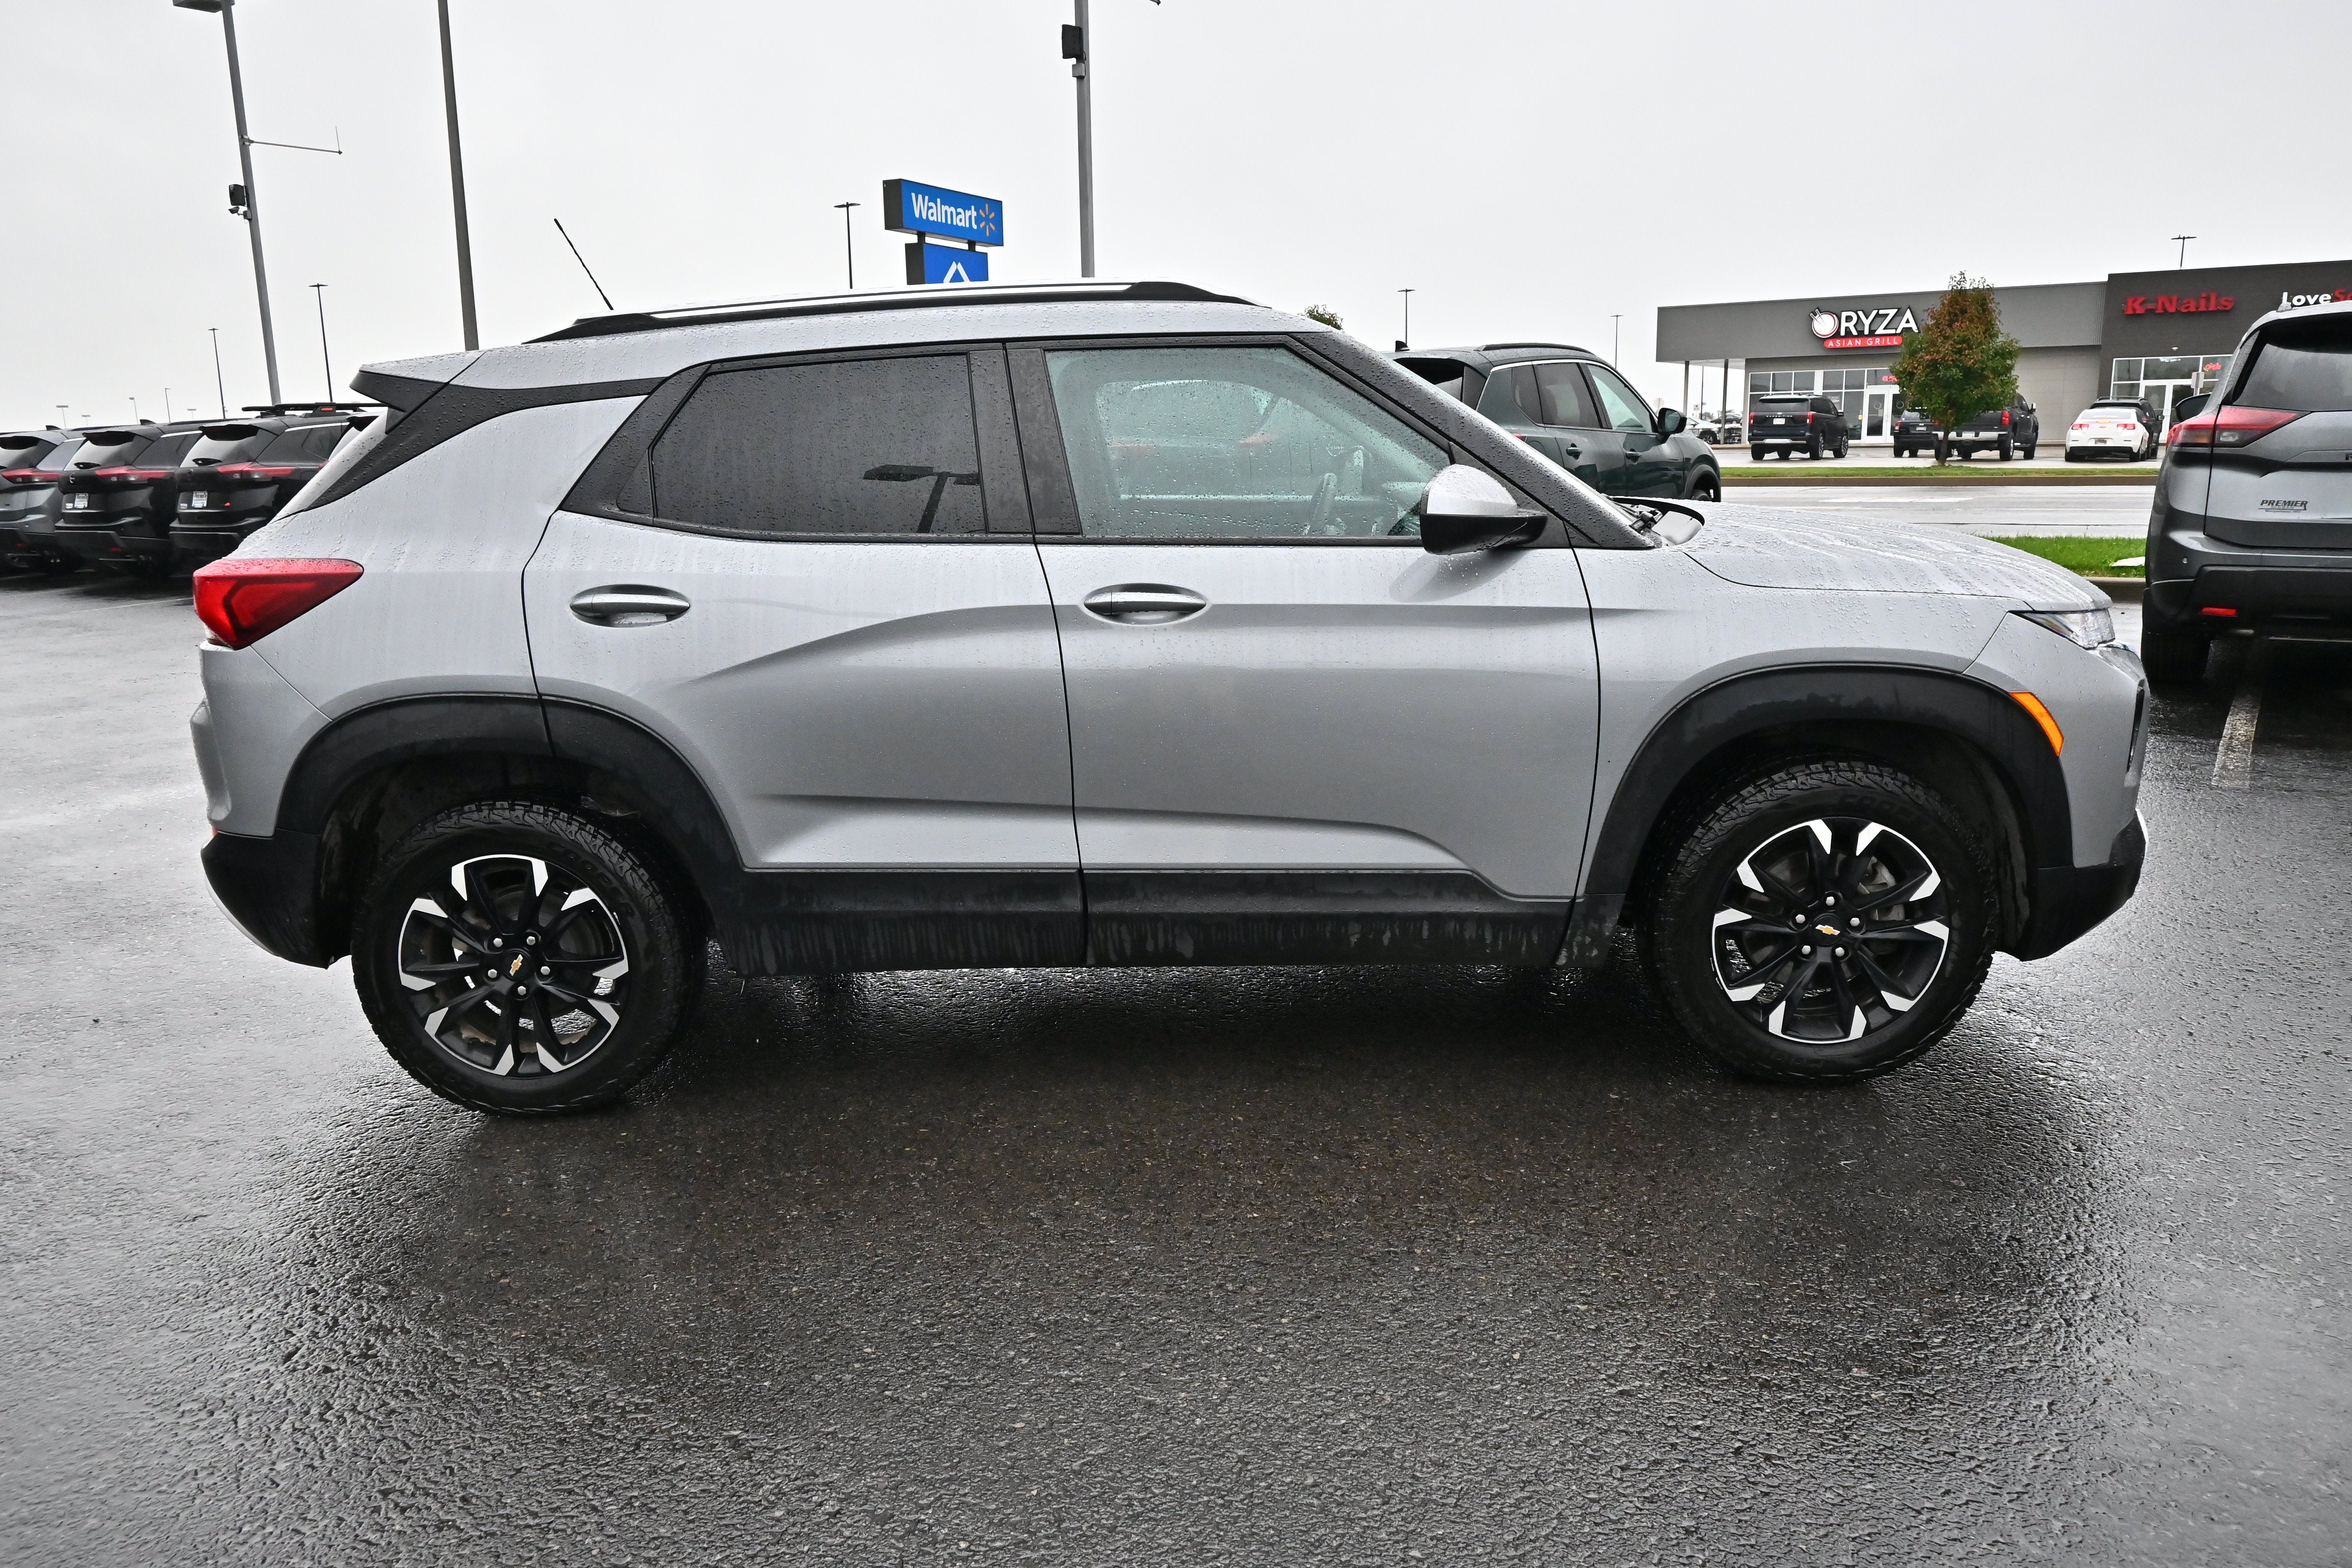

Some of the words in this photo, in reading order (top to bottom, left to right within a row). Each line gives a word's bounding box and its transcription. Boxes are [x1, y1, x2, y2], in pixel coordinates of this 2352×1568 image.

[911, 192, 977, 229] Walmart
[2125, 292, 2235, 315] K-Nails
[2282, 291, 2331, 305] Love
[1828, 338, 1861, 347] ASIAN
[1866, 338, 1898, 346] GRILL
[2260, 500, 2308, 510] PREMIER
